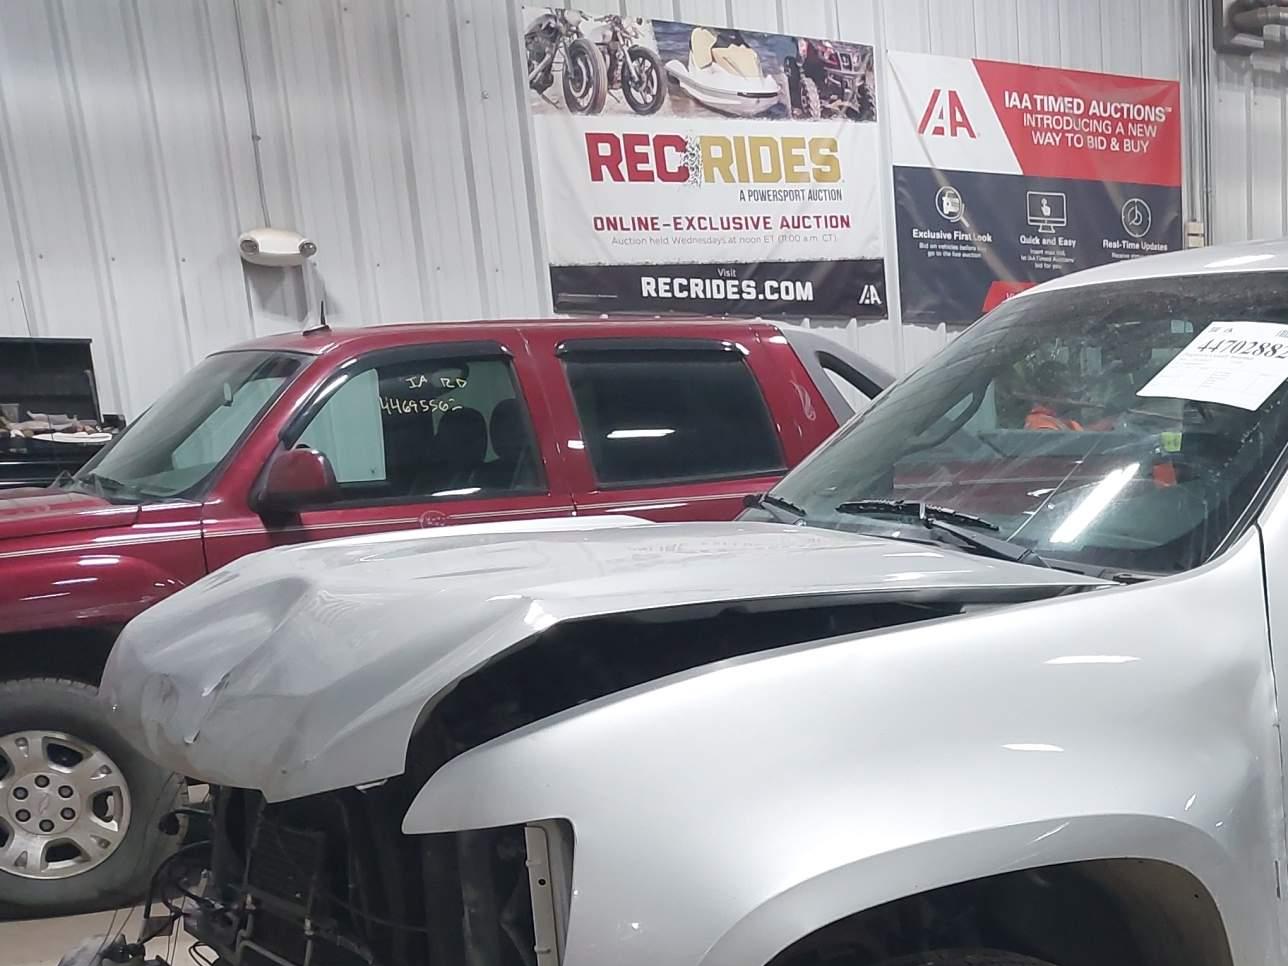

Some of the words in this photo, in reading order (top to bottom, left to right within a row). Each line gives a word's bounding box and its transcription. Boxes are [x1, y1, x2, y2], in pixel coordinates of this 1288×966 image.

[1004, 90, 1032, 110] IAA
[1033, 94, 1085, 114] TIMED
[1023, 113, 1111, 134] INTRODUCING
[1115, 122, 1124, 135] A
[1127, 123, 1157, 138] NEW
[1031, 131, 1062, 146] WAY
[1065, 133, 1084, 148] TO
[1087, 135, 1107, 150] BID
[1110, 136, 1120, 151] &
[1123, 137, 1150, 153] BUY
[739, 189, 745, 201] A
[748, 189, 805, 202] POWERSPORT
[807, 188, 843, 202] AUCTION
[593, 216, 772, 231] ONLINE-EXCLUSIVE
[779, 214, 851, 229] AUCTION
[611, 236, 647, 245] Auction
[649, 236, 669, 245] held
[671, 236, 726, 246] Wednesdays
[728, 236, 737, 244] at
[739, 236, 761, 244] noon
[912, 228, 952, 240] Exclusive
[954, 230, 972, 241] First
[973, 232, 992, 242] Look
[1019, 235, 1040, 245] Quick
[1042, 236, 1056, 246] and
[1058, 237, 1076, 248] Easy
[1102, 239, 1140, 249] Real-Time
[1140, 240, 1168, 252] Updates
[717, 268, 737, 278] Visit
[641, 276, 814, 301] RECRIDES.COM
